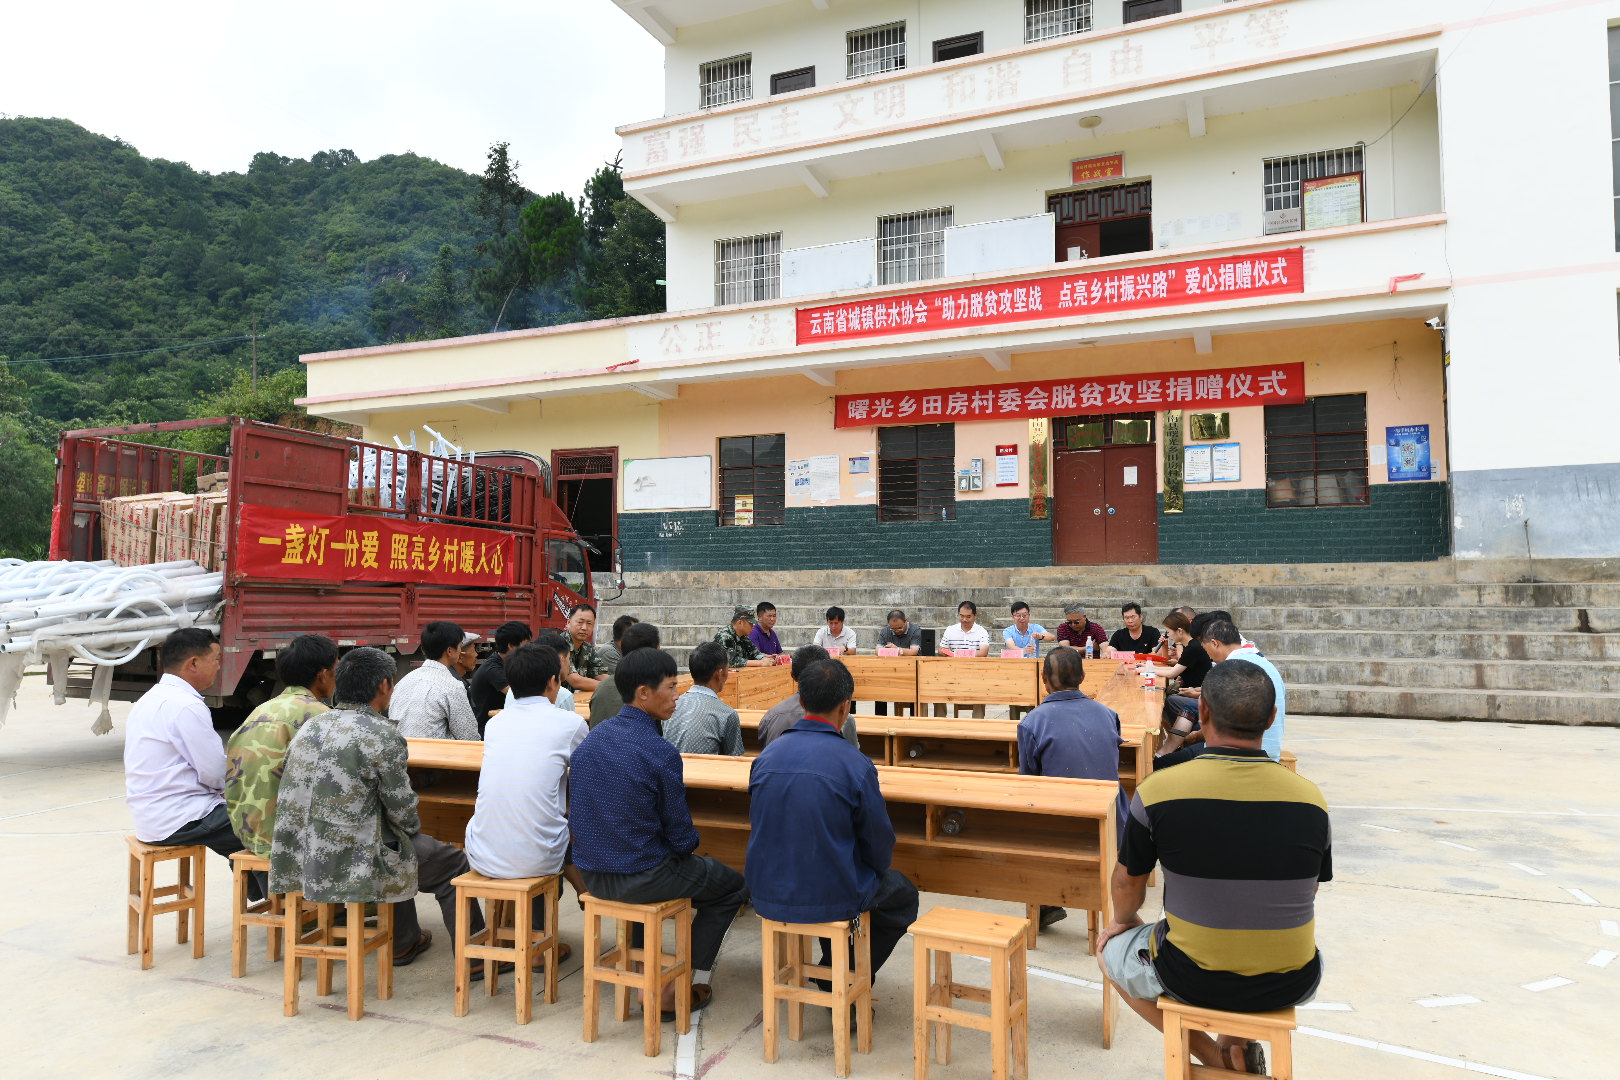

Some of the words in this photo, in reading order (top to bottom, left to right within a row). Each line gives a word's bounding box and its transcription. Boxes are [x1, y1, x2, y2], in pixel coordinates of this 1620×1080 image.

[643, 123, 706, 166] 富强
[732, 106, 800, 148] 民主
[832, 83, 906, 131] 文明
[941, 61, 1024, 108] 和谐
[1062, 38, 1144, 88] 自由
[1189, 9, 1289, 60] 平等
[809, 298, 928, 336] 云南省城镇供水协会
[935, 285, 1043, 321] “助力脱贫攻坚战
[1058, 269, 1177, 309] 点亮乡村振兴路”
[1185, 256, 1288, 295] 爱心捐赠仪式
[658, 320, 725, 353] 公正
[847, 369, 1288, 421] 曙光乡田房村委会脱贫攻坚捐赠仪式
[258, 523, 380, 569] 一盏灯一份爱
[389, 533, 504, 575] 照亮乡村暖人心
